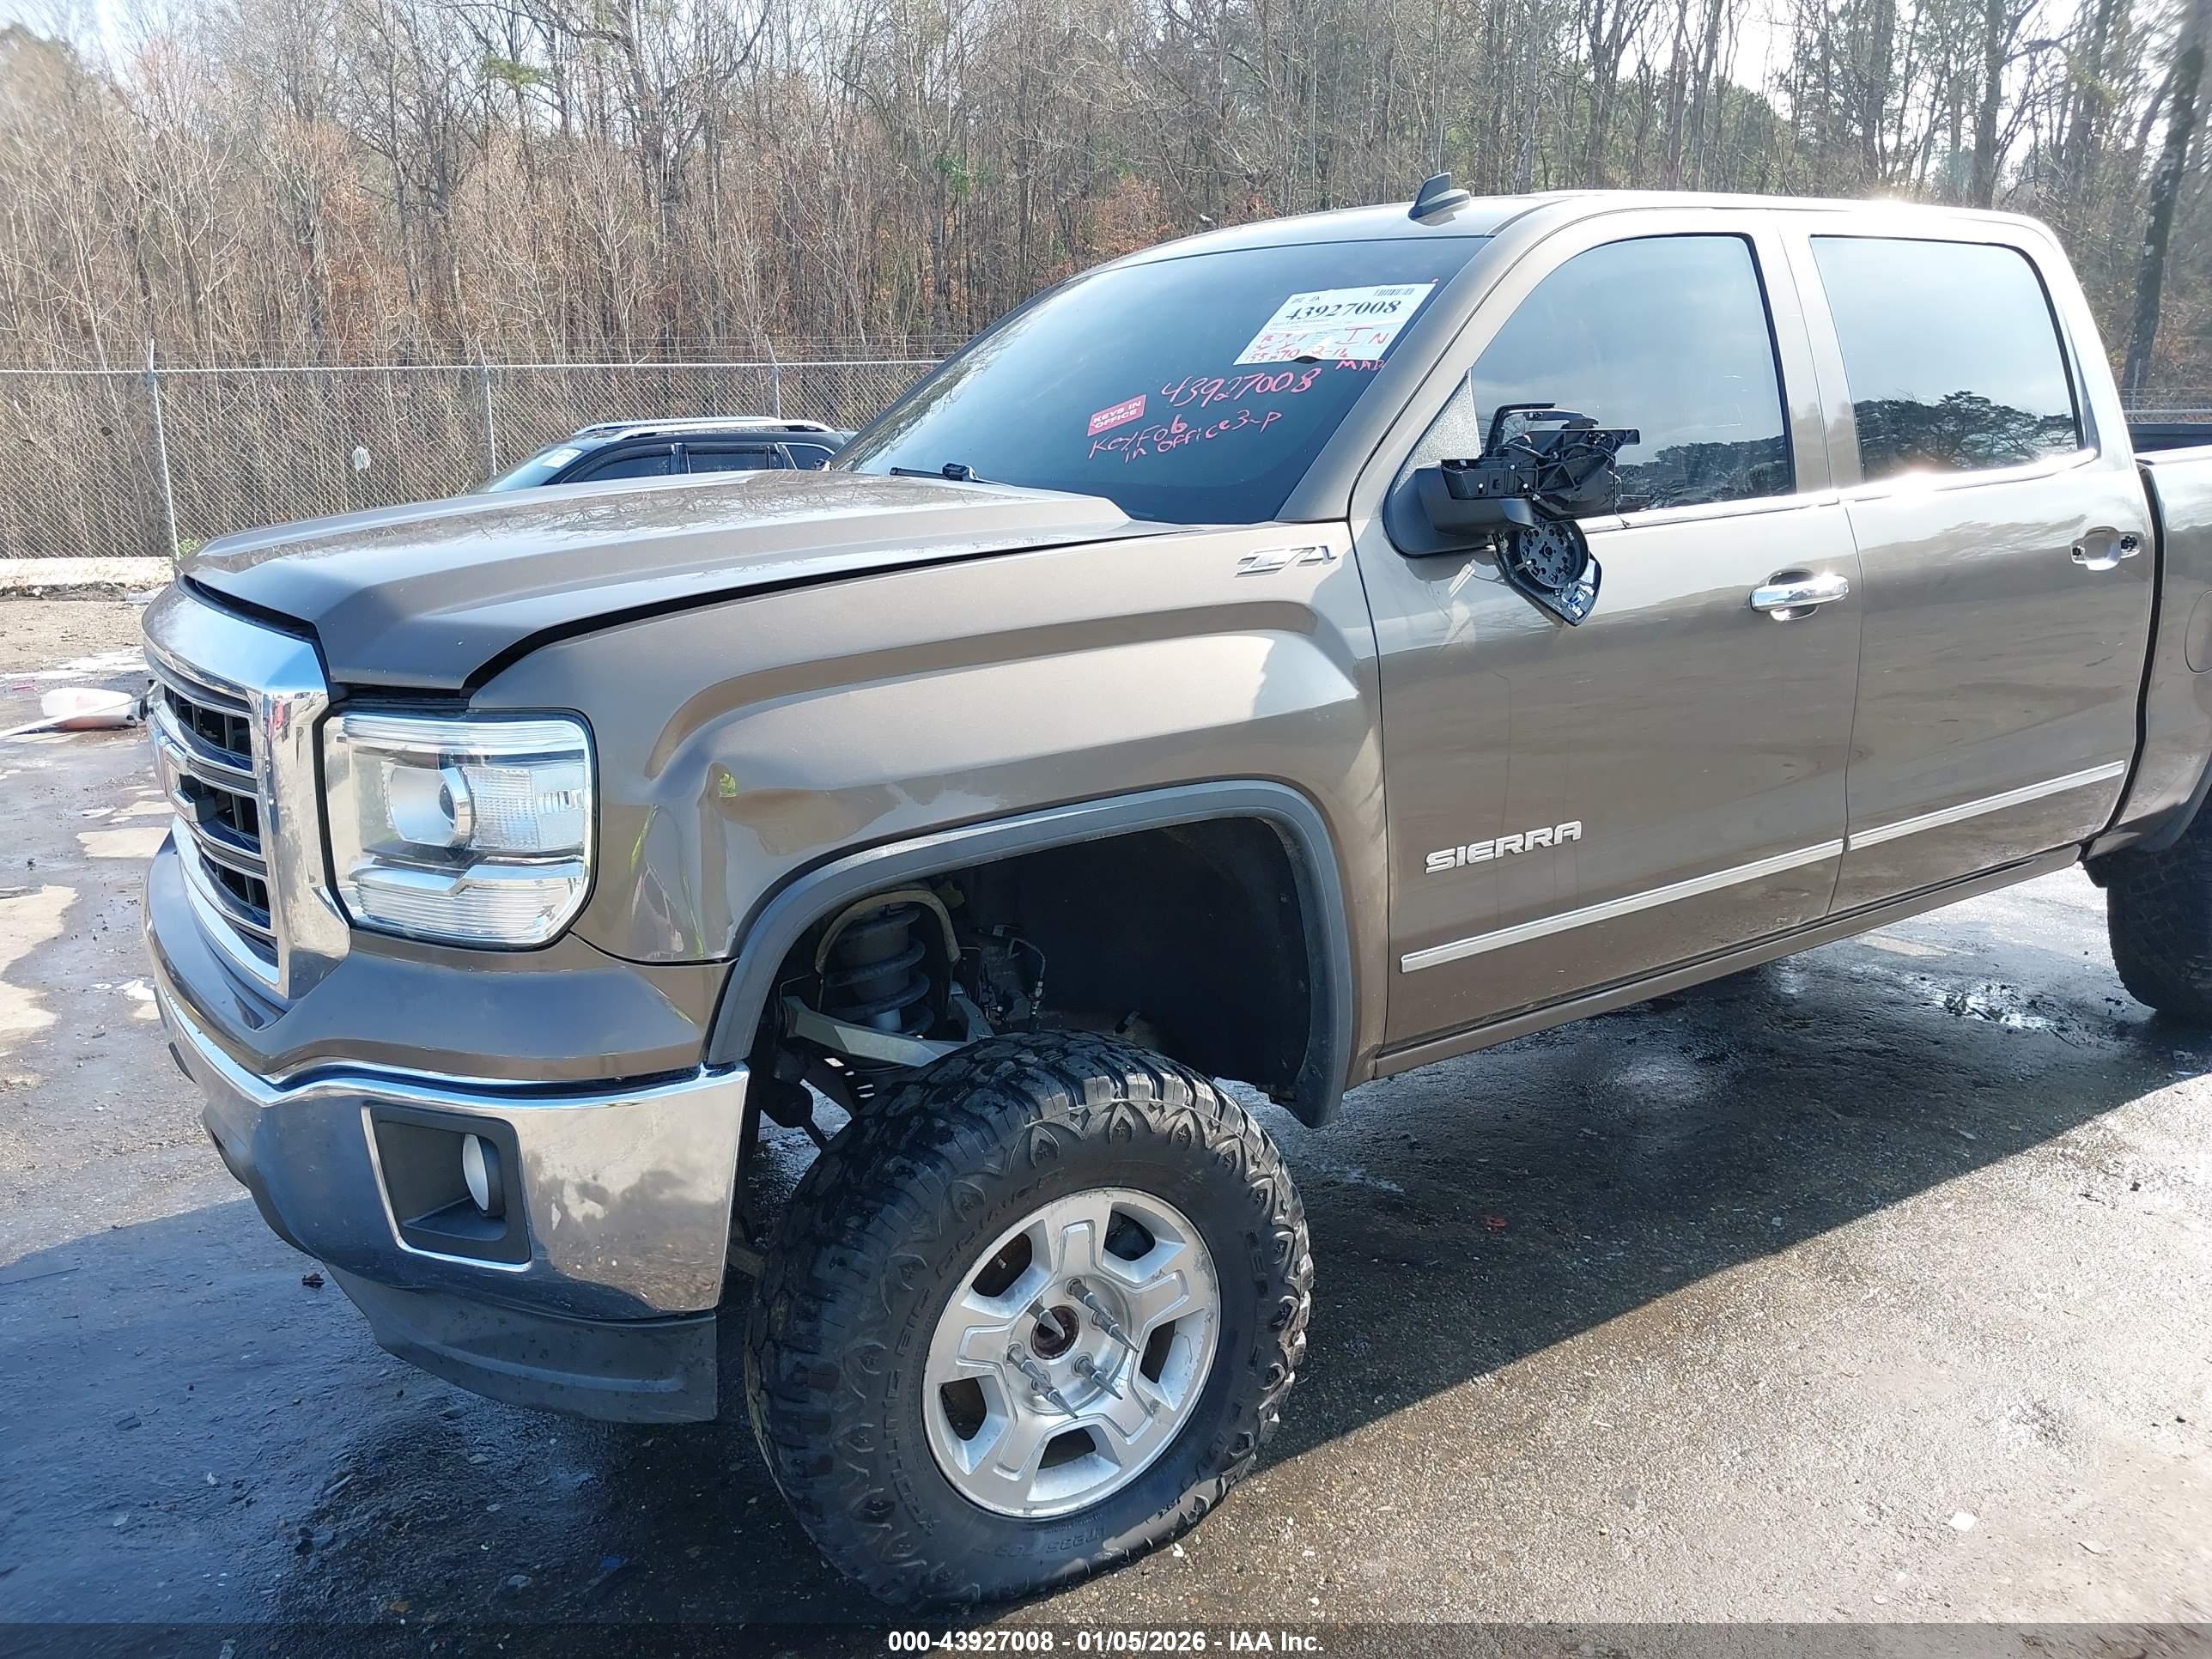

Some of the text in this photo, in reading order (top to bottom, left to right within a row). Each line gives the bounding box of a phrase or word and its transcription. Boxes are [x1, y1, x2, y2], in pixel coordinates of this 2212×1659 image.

[1285, 300, 1402, 320] 43927008
[1161, 368, 1322, 408] 43927008
[1093, 400, 1141, 423] KEYS IN
[1094, 408, 1138, 428] OFFICE
[1424, 819, 1583, 874] SIERRA
